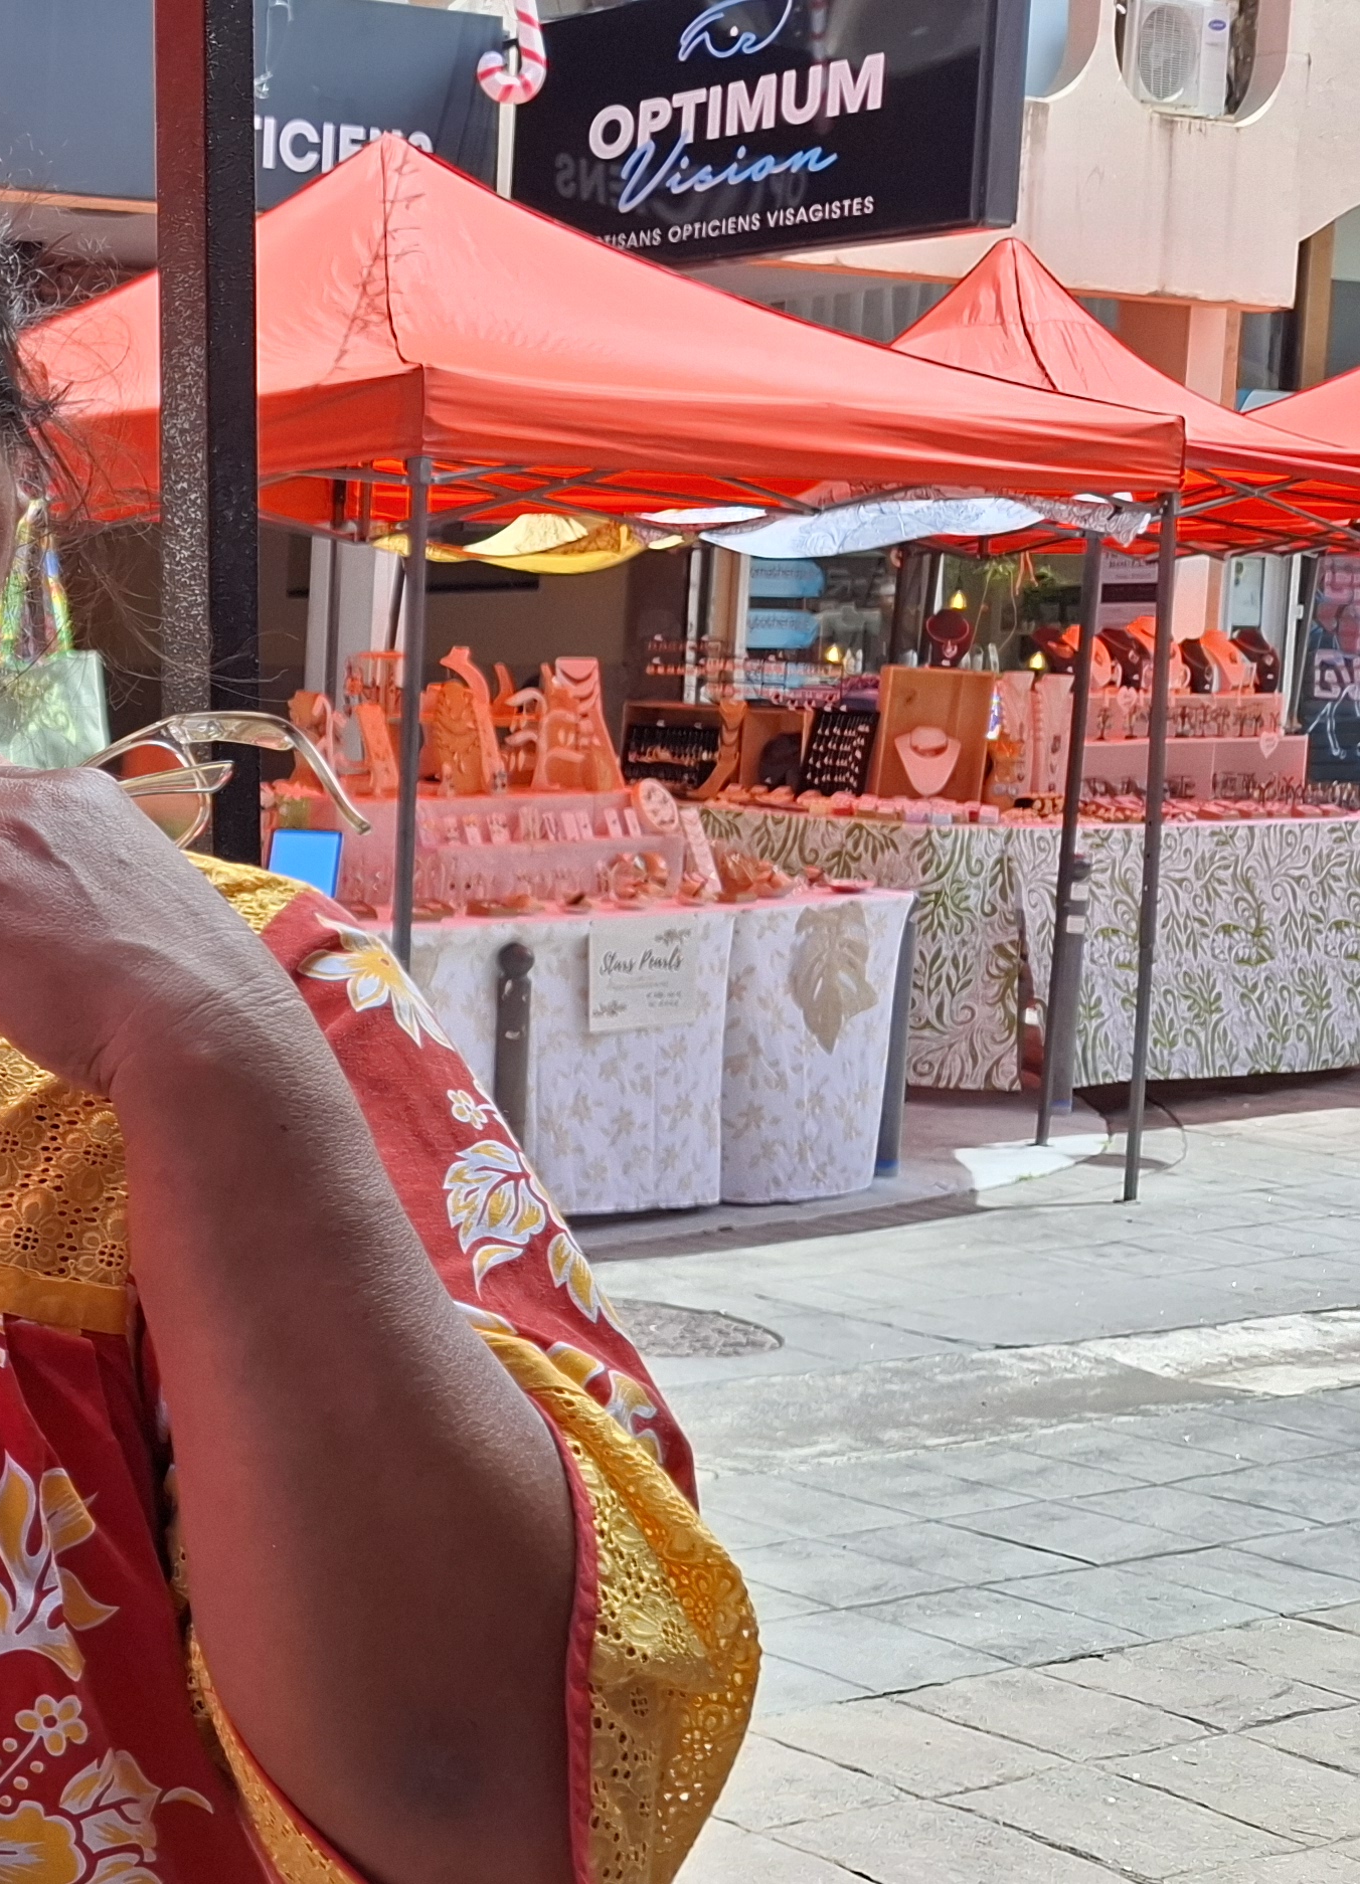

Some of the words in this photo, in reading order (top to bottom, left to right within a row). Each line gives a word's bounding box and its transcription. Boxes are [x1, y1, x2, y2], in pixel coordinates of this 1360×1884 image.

[588, 52, 885, 160] OPTIMUM
[618, 128, 838, 213] Vision
[668, 212, 760, 243] OPTICIENS
[766, 195, 875, 228] VISAGISTES
[638, 945, 684, 972] Pearls
